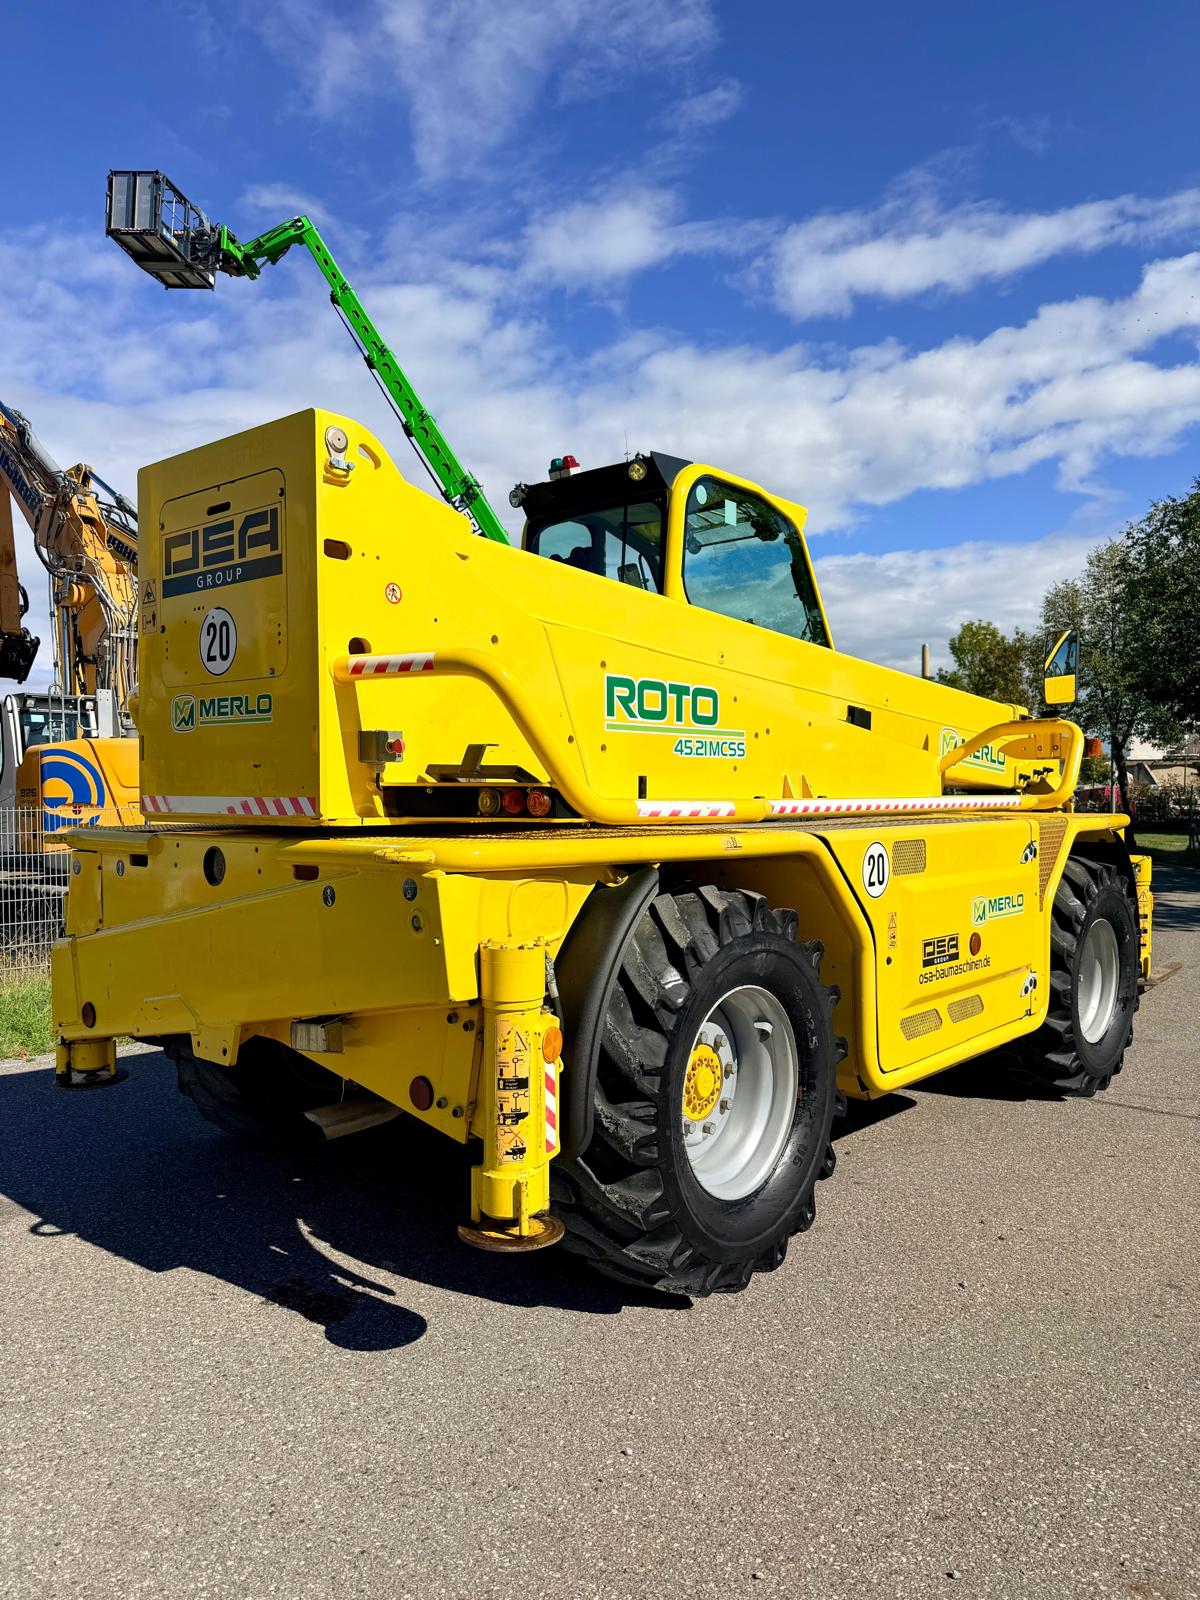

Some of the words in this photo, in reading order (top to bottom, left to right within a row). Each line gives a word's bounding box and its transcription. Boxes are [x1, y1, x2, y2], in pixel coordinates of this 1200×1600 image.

[196, 567, 242, 588] GROUP
[206, 621, 230, 662] 20
[199, 693, 272, 718] MERLO
[606, 675, 719, 726] ROTO
[867, 852, 885, 888] 20
[988, 893, 1024, 914] MERLO
[918, 954, 991, 985] osa-baumaschinen.de
